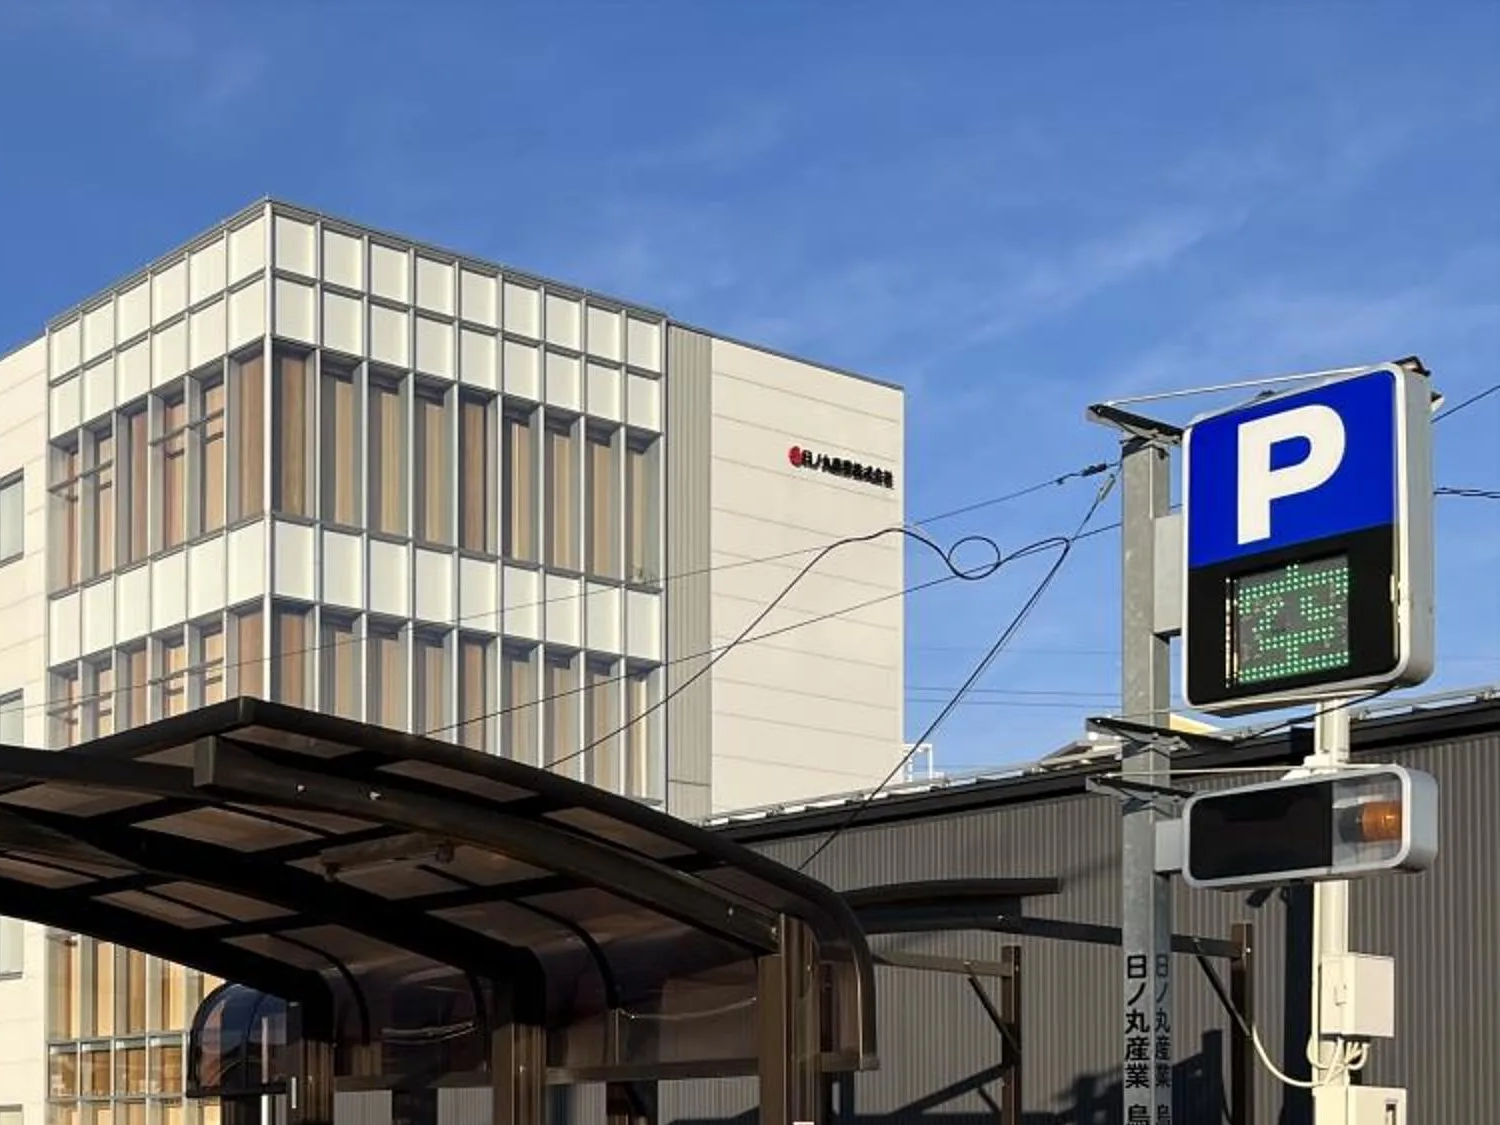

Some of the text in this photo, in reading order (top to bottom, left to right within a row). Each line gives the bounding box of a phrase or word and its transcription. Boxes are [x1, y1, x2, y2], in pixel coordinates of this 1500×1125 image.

[1237, 404, 1346, 545] P
[1125, 954, 1150, 1089] 日ノ丸産業
